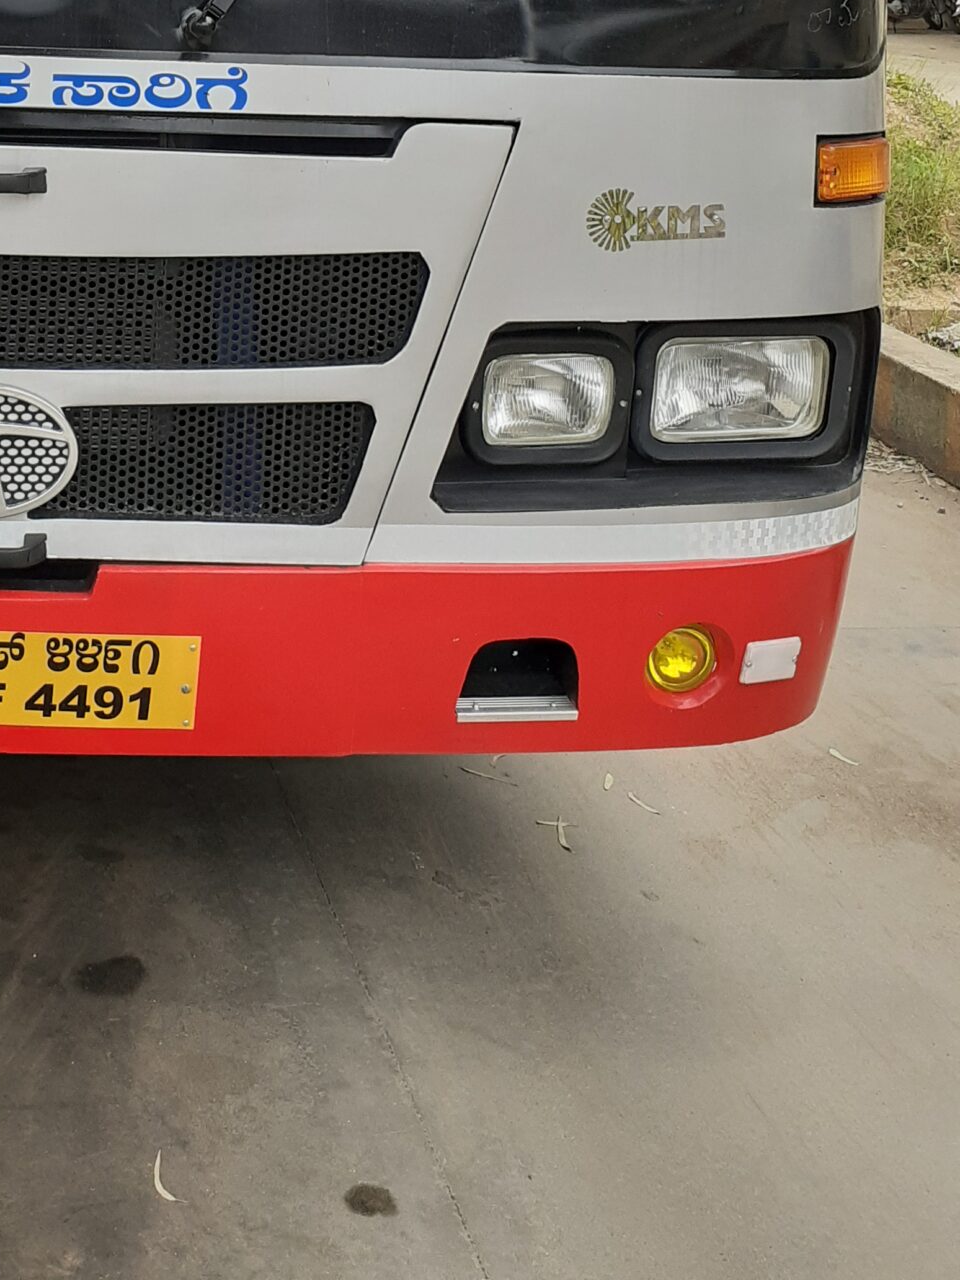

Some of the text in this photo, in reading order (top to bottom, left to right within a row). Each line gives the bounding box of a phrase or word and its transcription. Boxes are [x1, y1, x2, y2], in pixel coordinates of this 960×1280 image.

[51, 66, 249, 112] ಸಾರಿಗೆ
[631, 204, 726, 242] KMS
[24, 683, 153, 721] 4491
